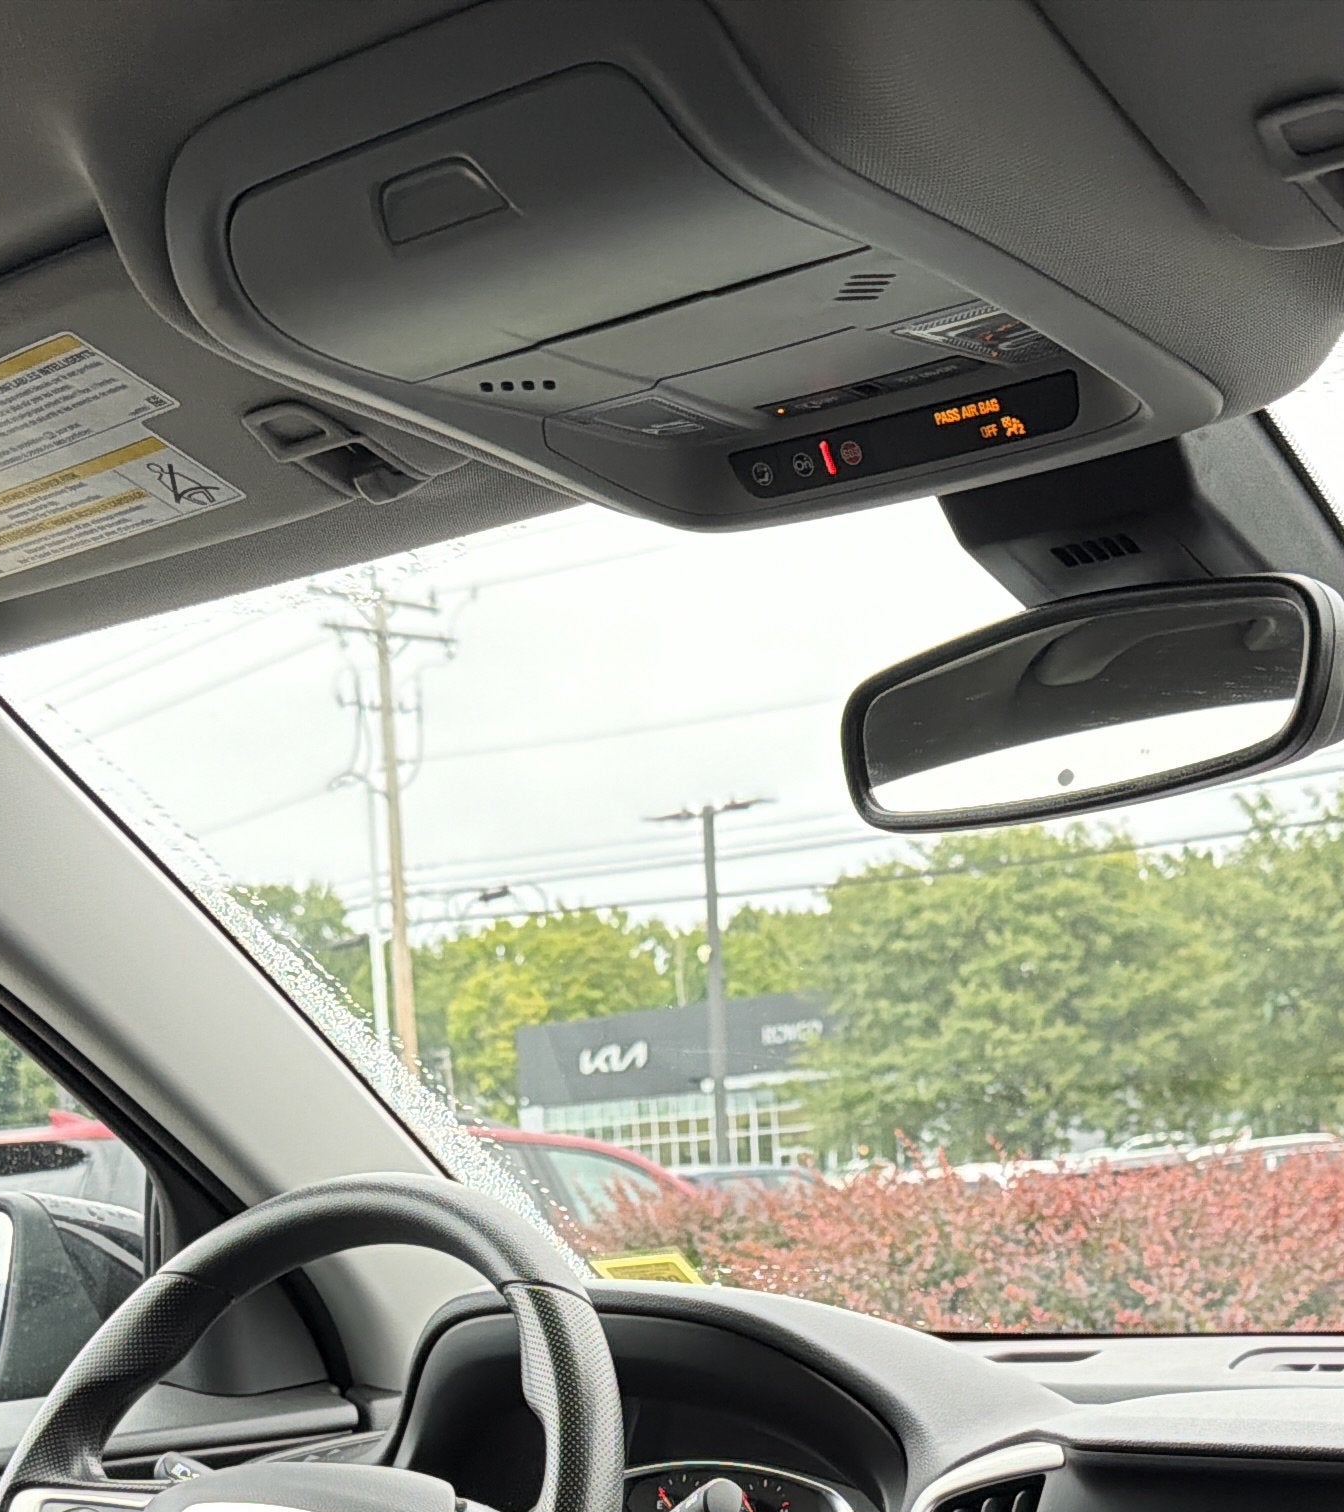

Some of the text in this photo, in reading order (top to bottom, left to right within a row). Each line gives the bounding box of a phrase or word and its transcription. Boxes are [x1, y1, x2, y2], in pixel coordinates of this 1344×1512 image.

[933, 398, 1001, 426] PASS AIR BAG
[979, 423, 999, 439] OFF
[578, 1039, 649, 1076] KIA
[657, 1501, 663, 1510] E
